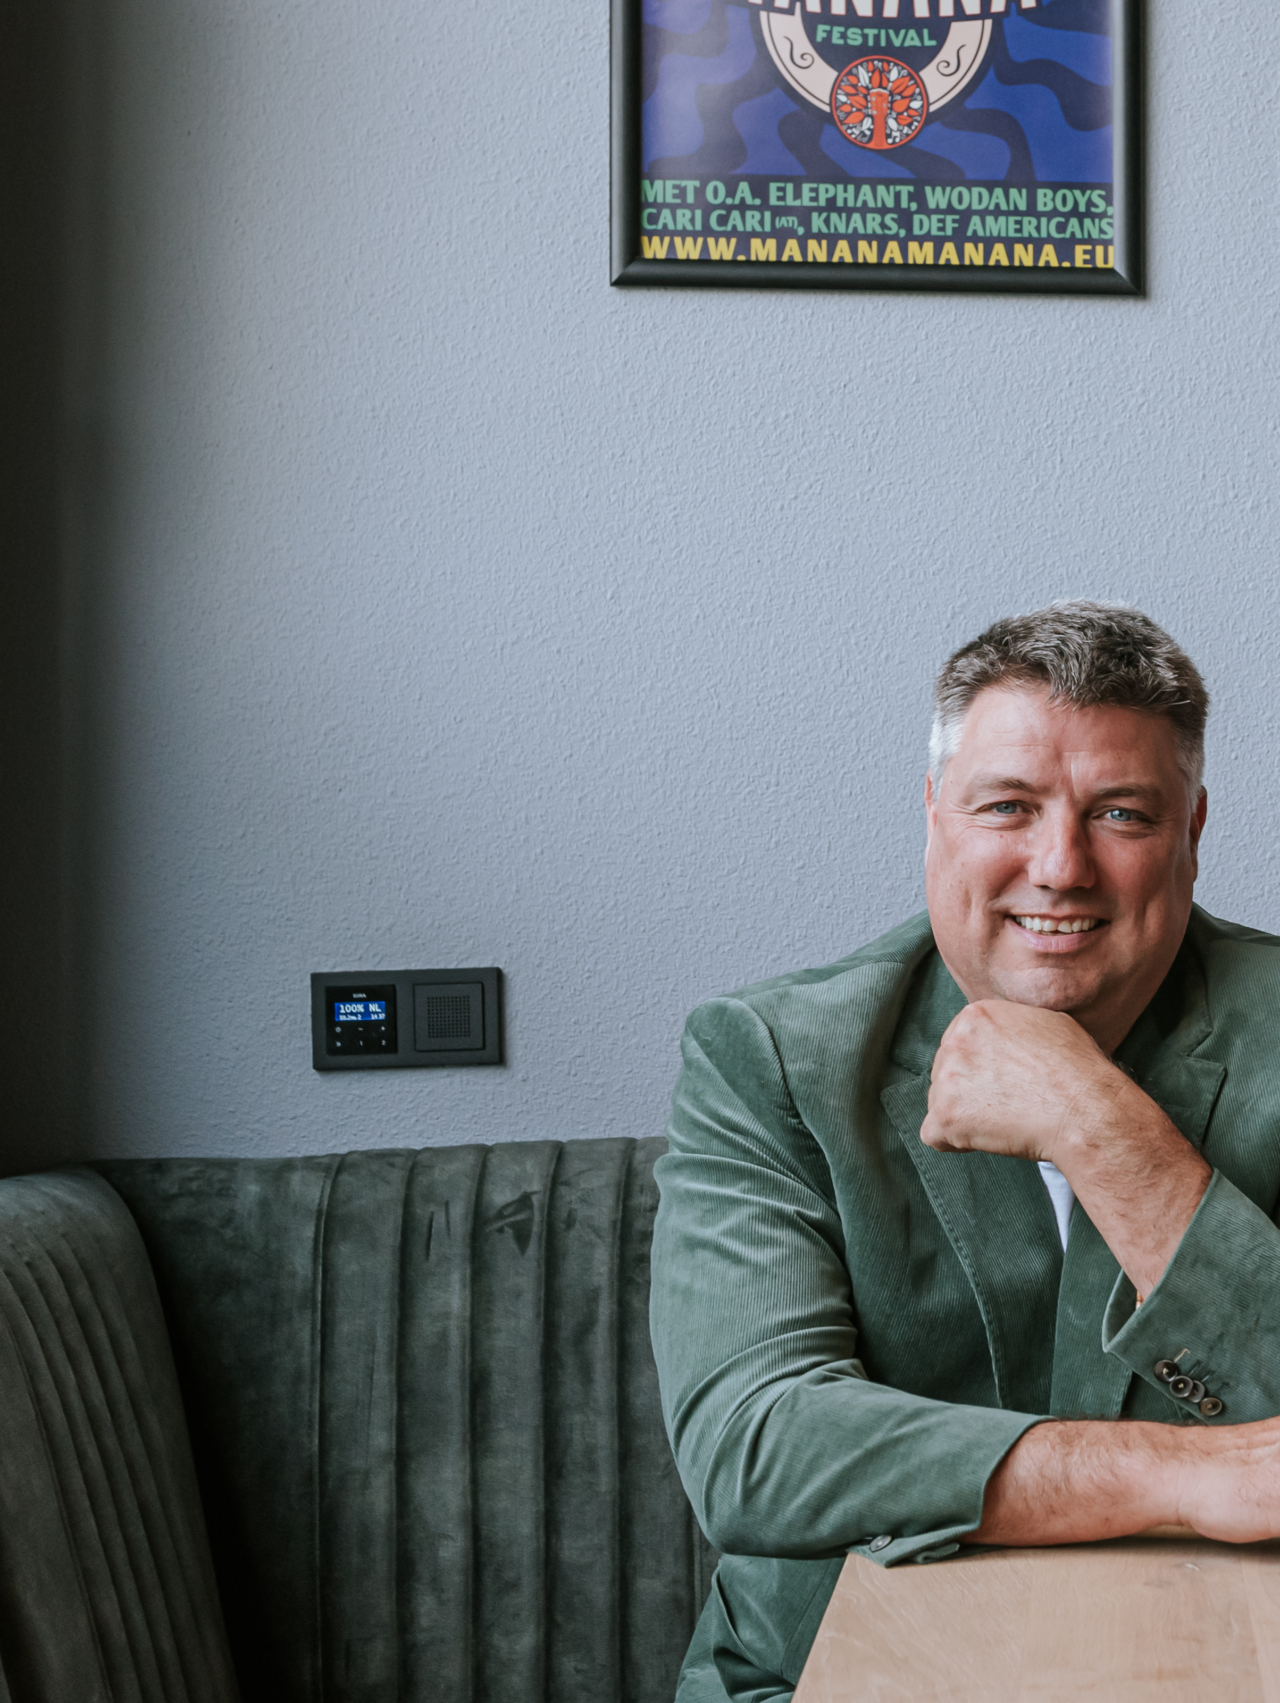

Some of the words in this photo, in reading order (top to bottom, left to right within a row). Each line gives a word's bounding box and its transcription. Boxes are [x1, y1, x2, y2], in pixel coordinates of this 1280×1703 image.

[815, 24, 938, 48] FESTIVAL
[641, 179, 700, 204] MET
[705, 180, 762, 206] O.A.
[768, 182, 919, 212] ELEPHANT,
[924, 185, 1028, 212] WODAN
[1036, 187, 1114, 216] BOYS,
[640, 208, 703, 232] CARI
[708, 209, 772, 233] CARI
[810, 211, 907, 238] KNARS,
[912, 214, 960, 237] DEF
[965, 214, 1114, 240] AMERICANS
[641, 235, 1115, 269] WWW.MANANAMANANA.EU
